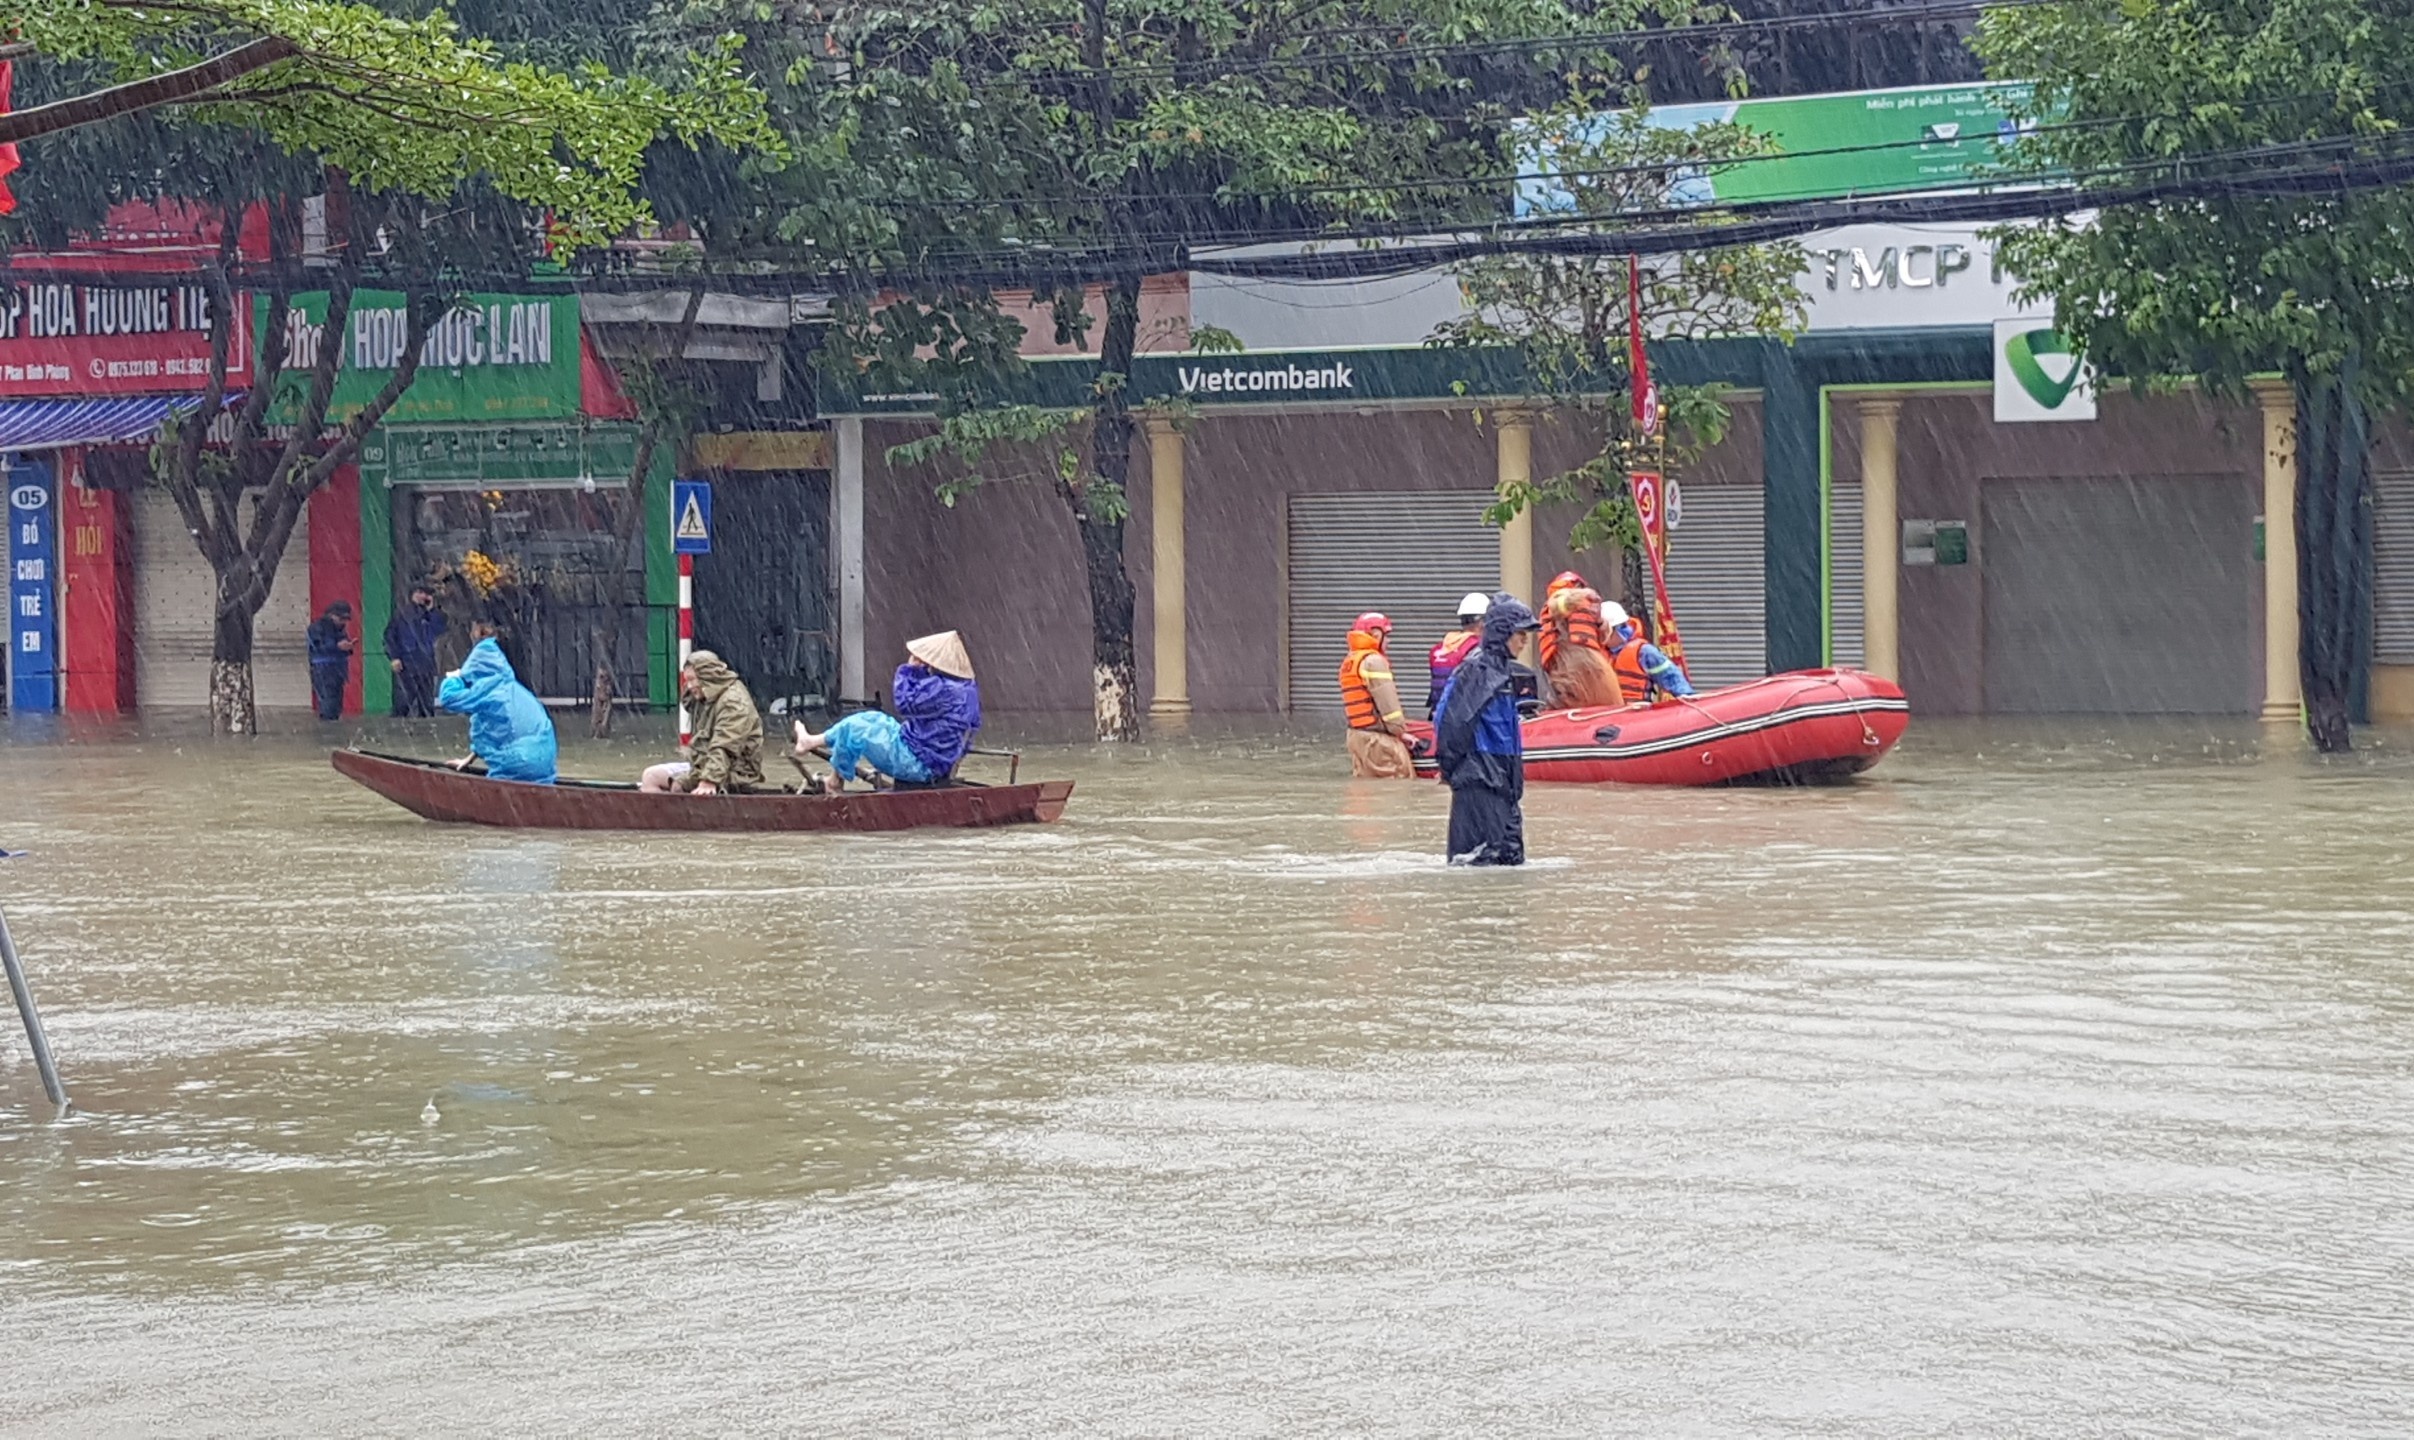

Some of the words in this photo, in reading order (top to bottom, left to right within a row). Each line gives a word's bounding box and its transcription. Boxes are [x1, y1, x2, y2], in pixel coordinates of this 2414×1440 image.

[1815, 244, 1971, 291] TMCP
[29, 284, 77, 337] HOA
[490, 301, 551, 364] LAN
[1178, 362, 1353, 392] Vietcombank
[364, 447, 384, 461] 09
[18, 490, 42, 505] 05
